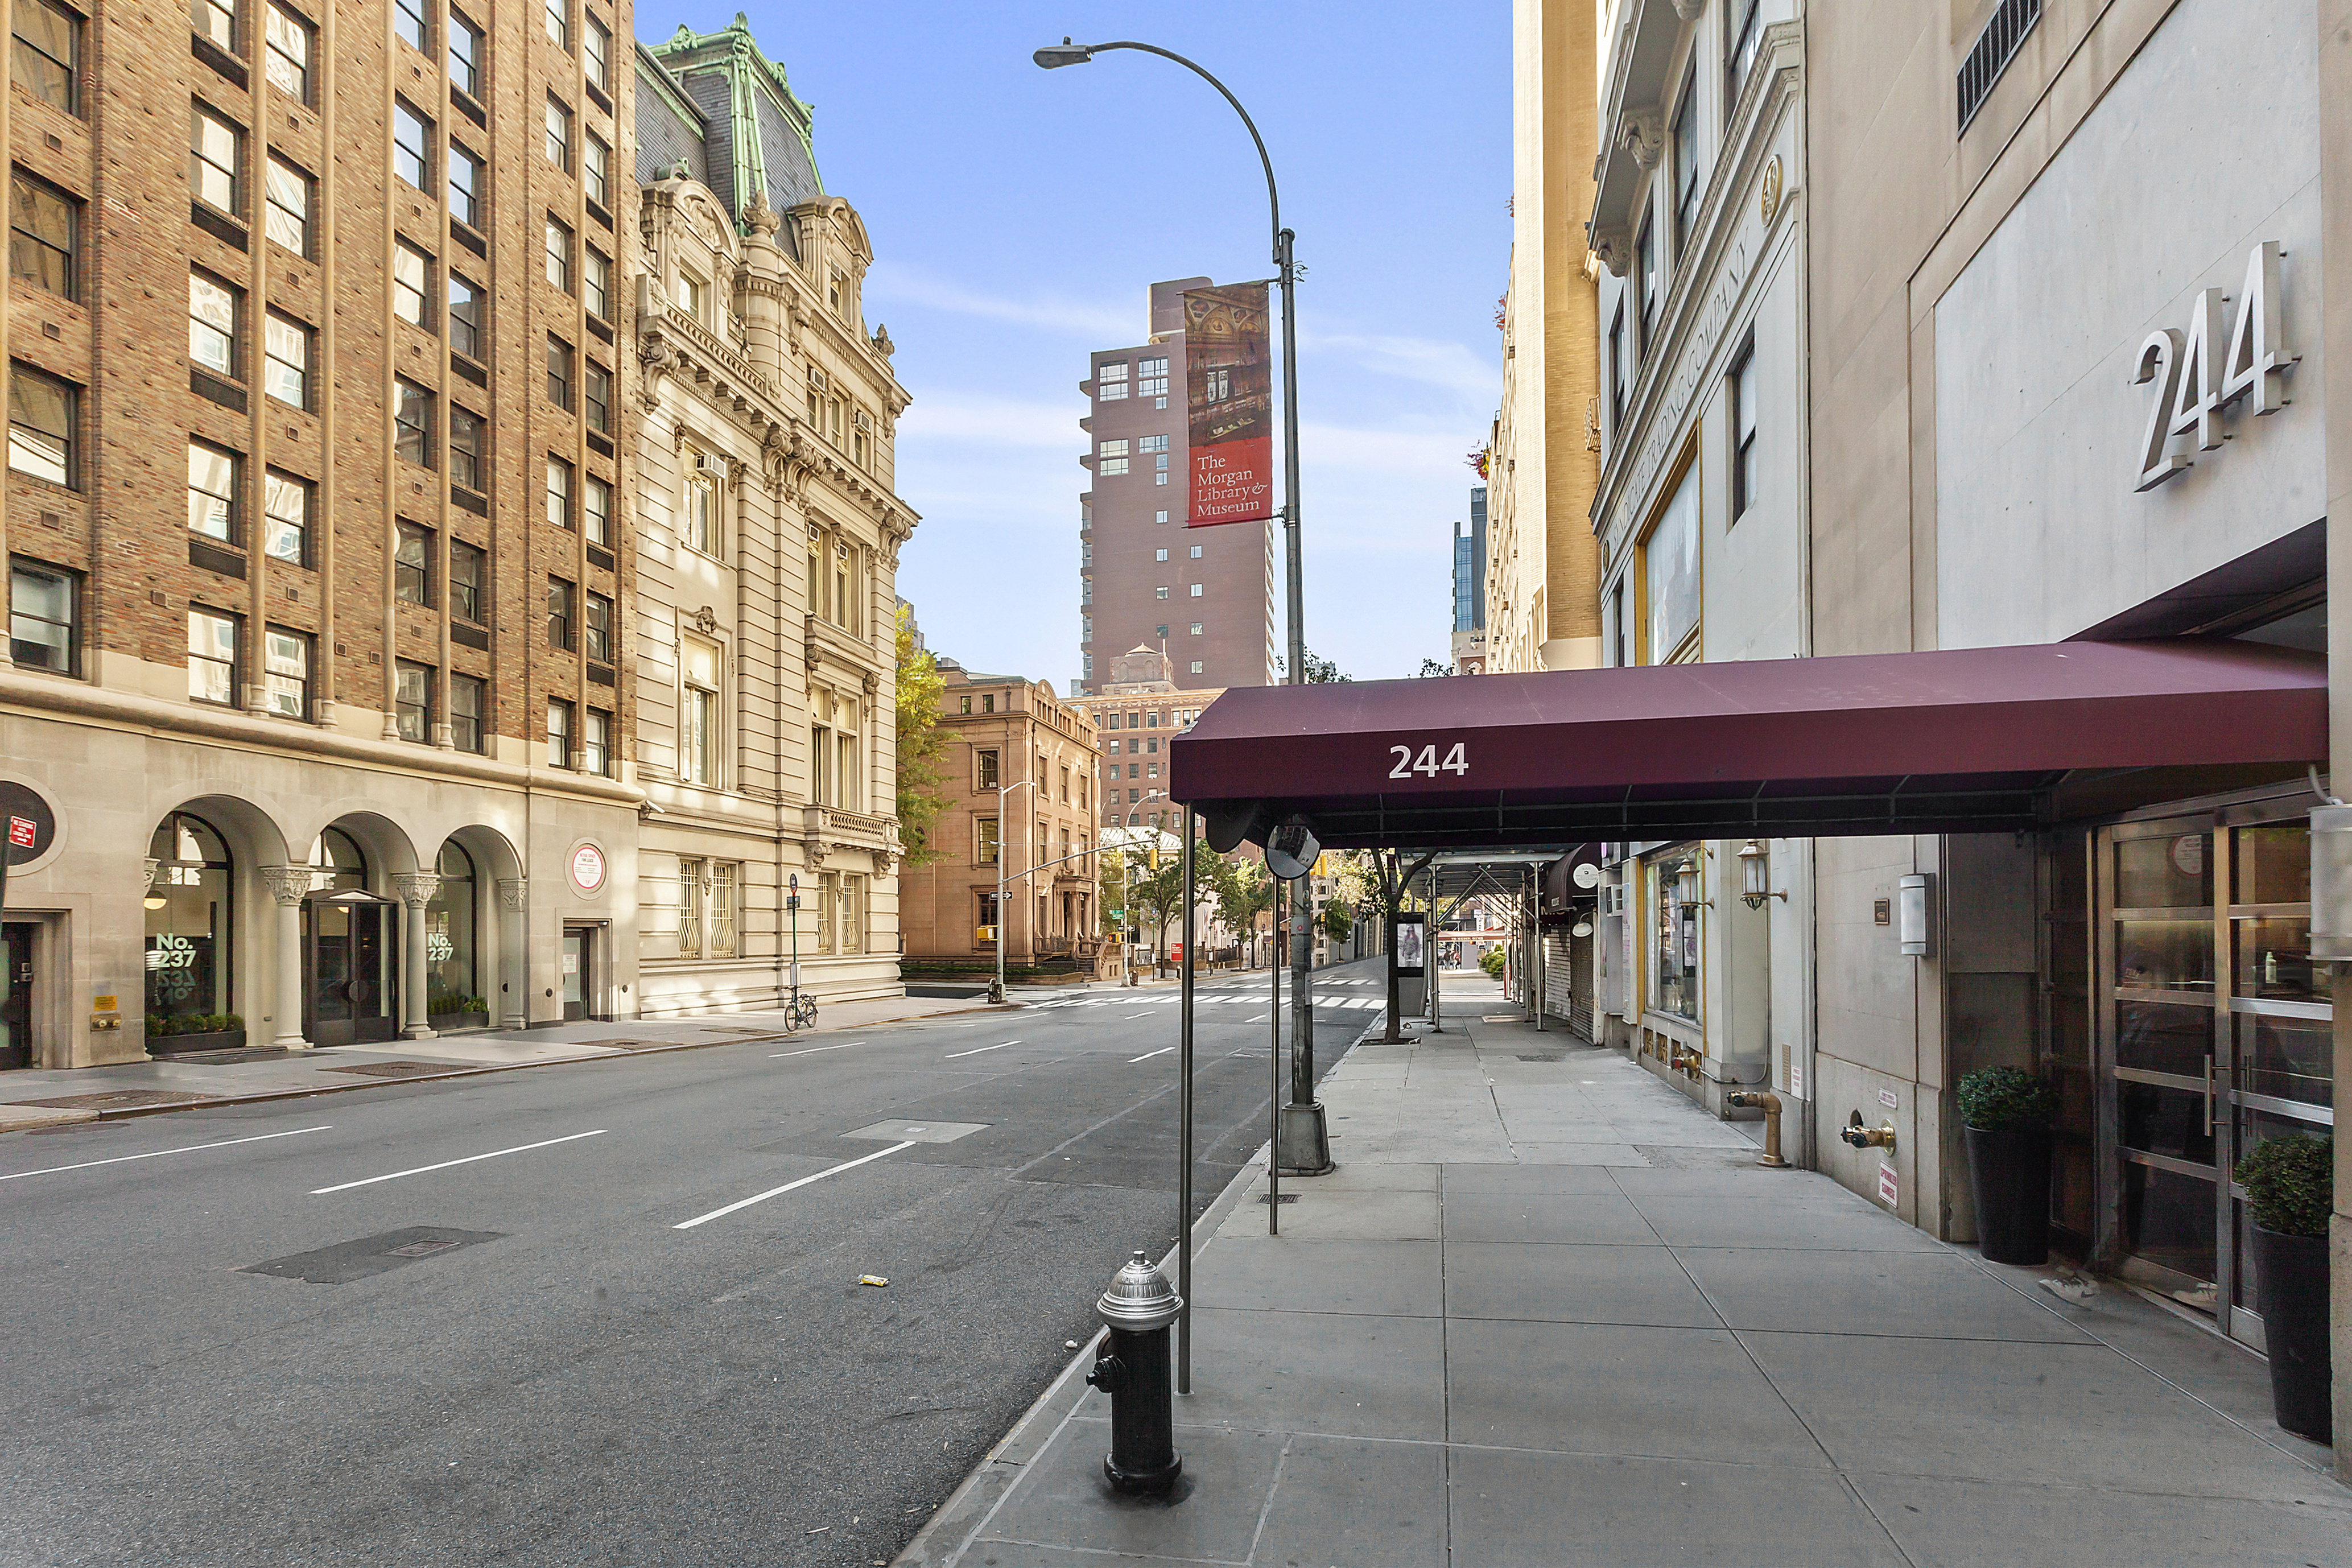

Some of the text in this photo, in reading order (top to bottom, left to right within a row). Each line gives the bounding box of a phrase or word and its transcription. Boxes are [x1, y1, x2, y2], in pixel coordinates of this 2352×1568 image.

[1647, 375, 1684, 478] TRADING
[1687, 225, 1749, 388] COMPANY
[2134, 240, 2292, 493] 244
[1197, 455, 1225, 470] The
[1198, 469, 1253, 486] Morgan
[1197, 501, 1260, 517] Museum
[1389, 742, 1469, 779] 244
[156, 933, 193, 950] No.
[428, 933, 452, 947] No.
[159, 950, 196, 967] 237
[428, 947, 453, 961] 237
